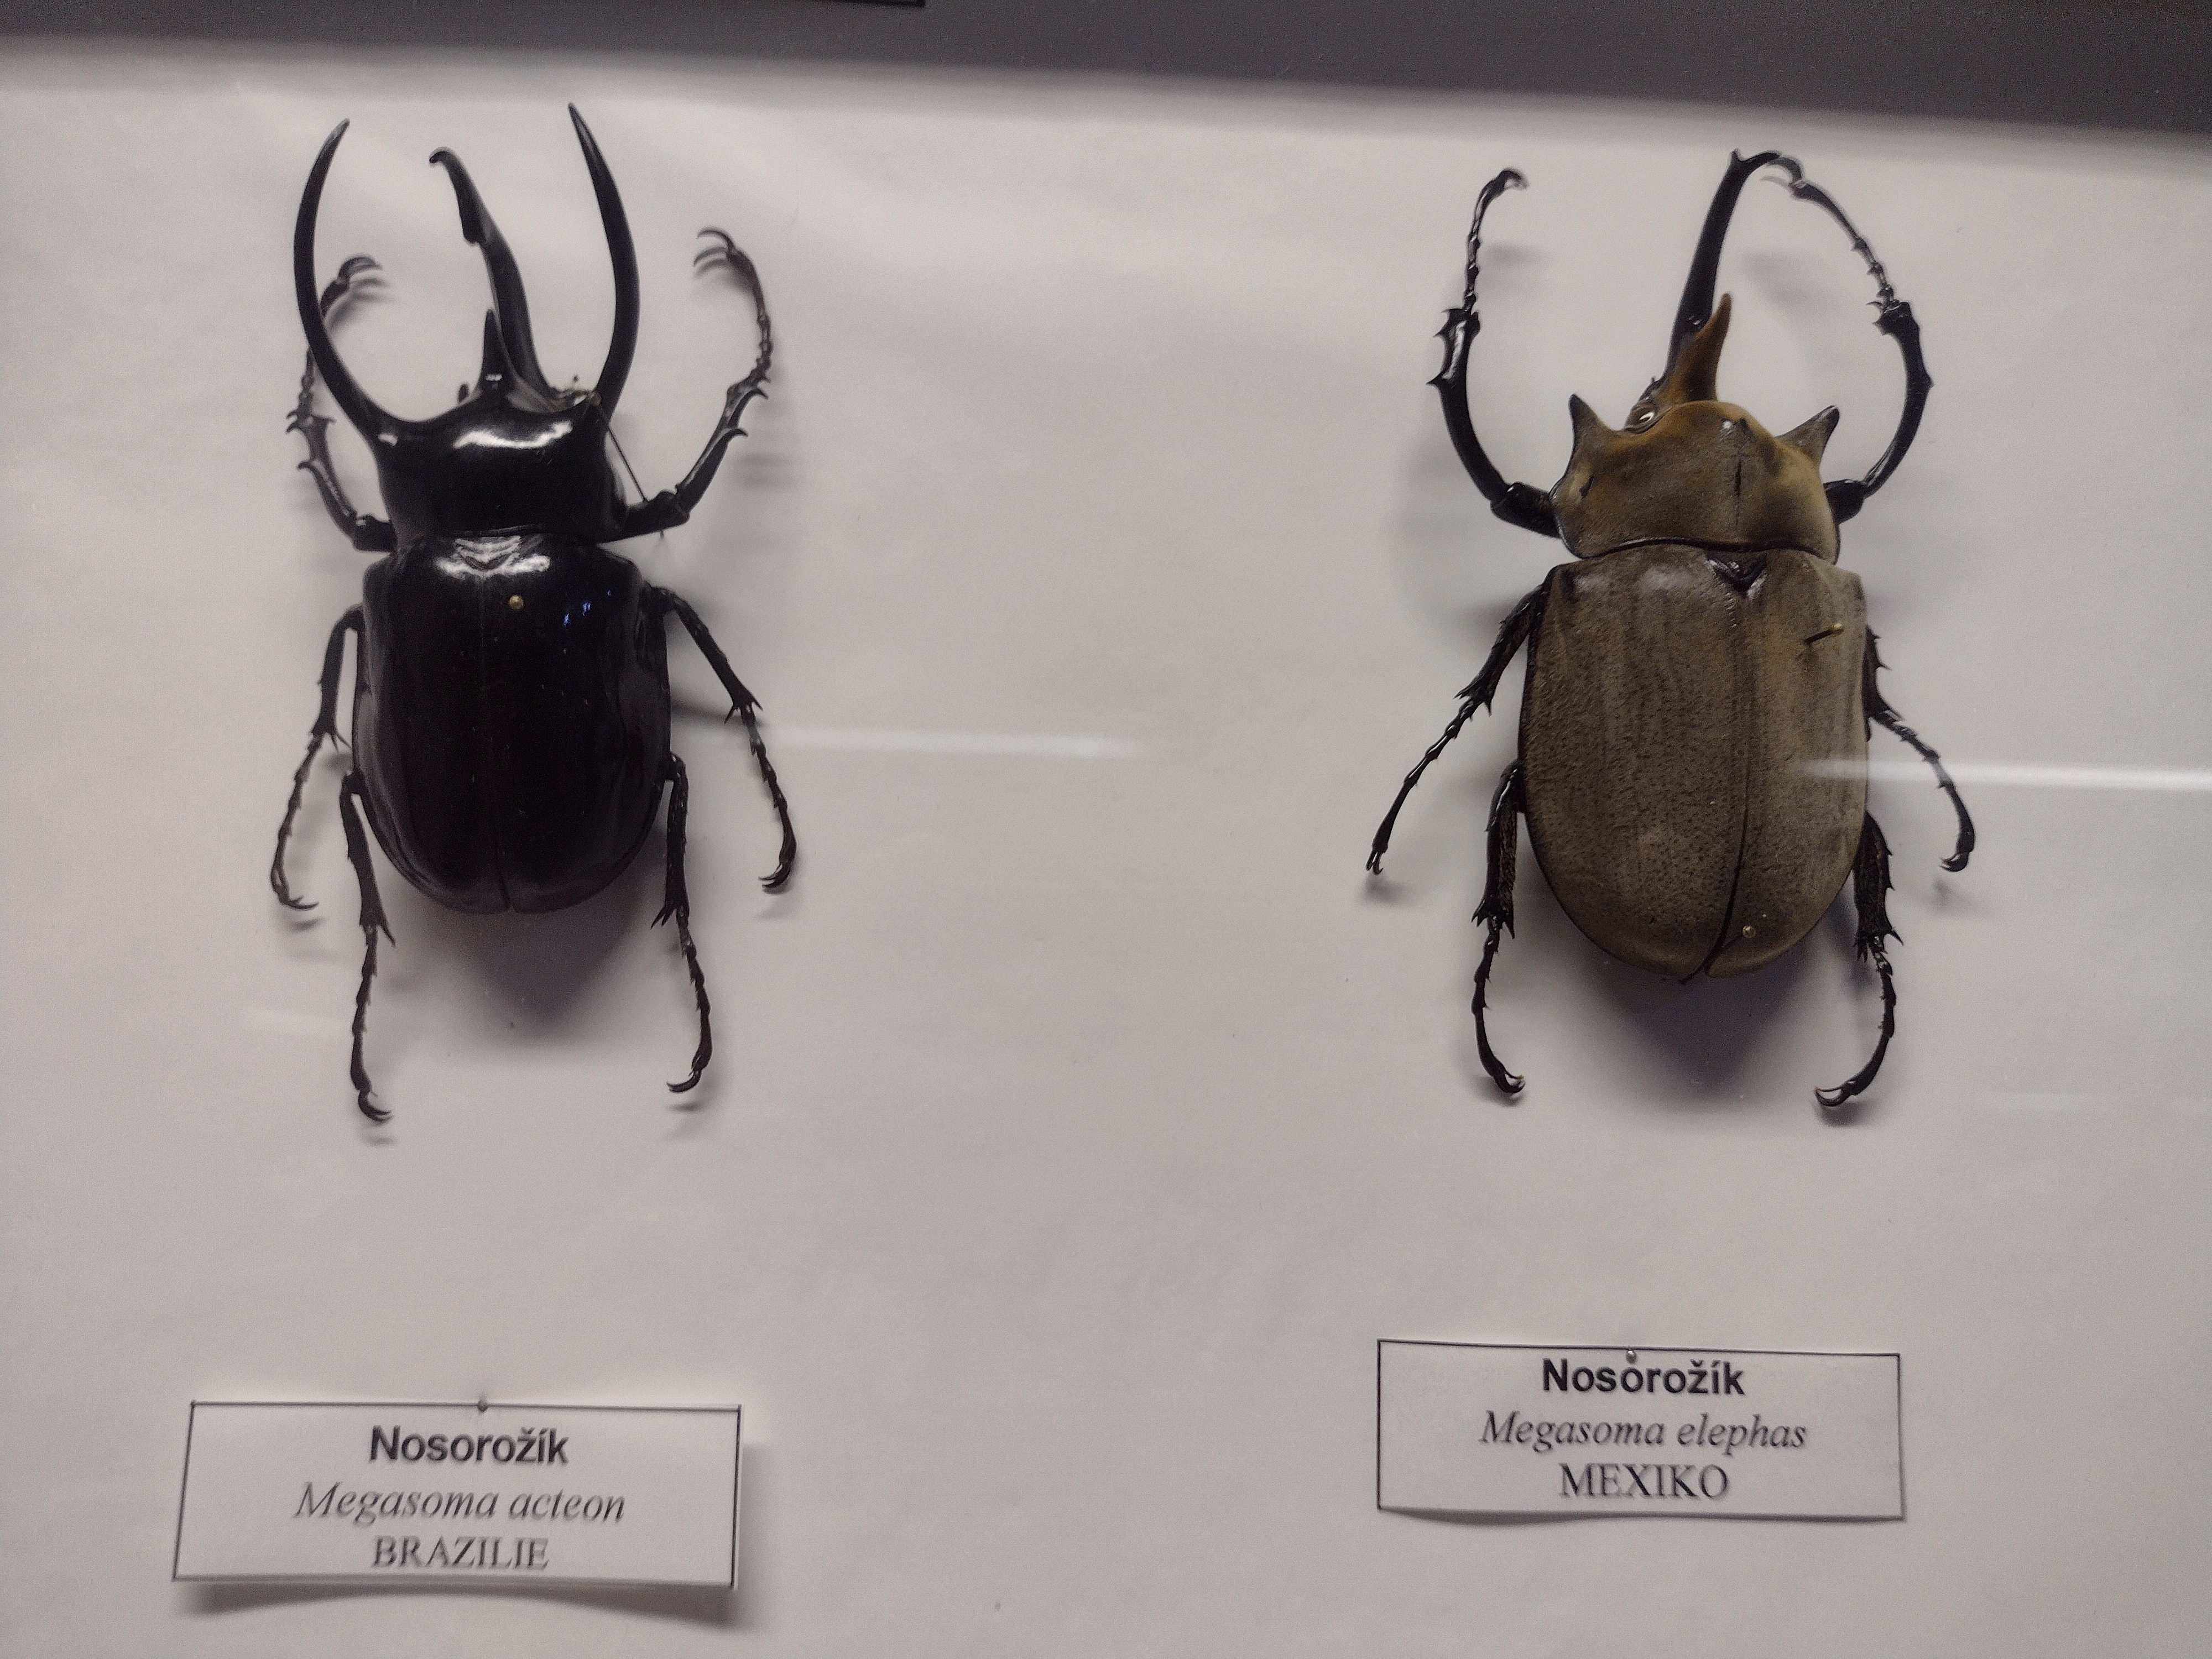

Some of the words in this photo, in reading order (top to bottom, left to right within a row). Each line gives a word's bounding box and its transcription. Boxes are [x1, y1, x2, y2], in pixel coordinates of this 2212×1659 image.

[1542, 1357, 1745, 1395] Nosorožík
[369, 1425, 569, 1464] Nosorožík
[1478, 1410, 1665, 1452] Megasoma
[1677, 1413, 1807, 1457] elephas
[1559, 1463, 1729, 1499] MEXIKO
[293, 1481, 498, 1526] Megasoma
[509, 1490, 625, 1522] acteon
[371, 1535, 549, 1569] BRAZILIE
